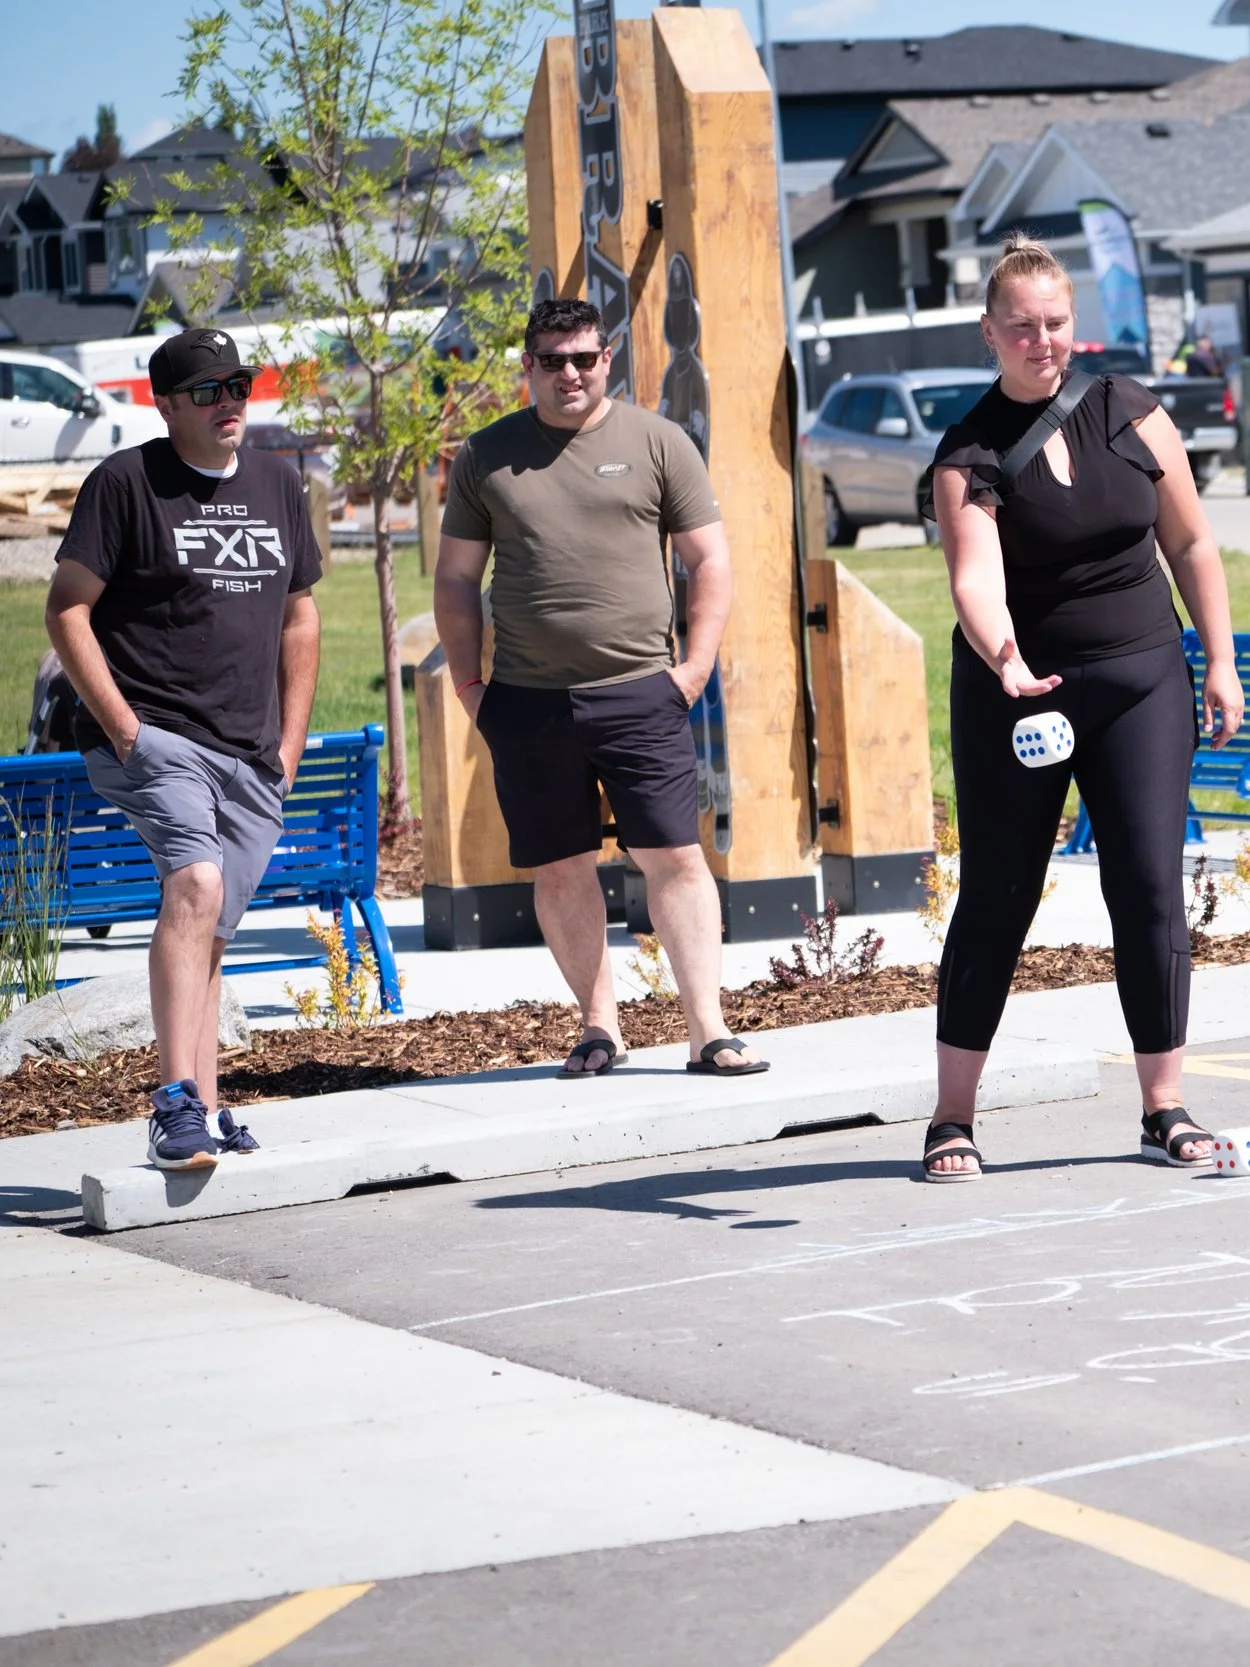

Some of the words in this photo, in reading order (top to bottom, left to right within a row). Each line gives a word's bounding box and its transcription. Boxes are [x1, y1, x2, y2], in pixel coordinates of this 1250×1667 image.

[200, 504, 248, 516] PRO
[172, 527, 286, 568] FXR
[212, 579, 262, 592] FISH
